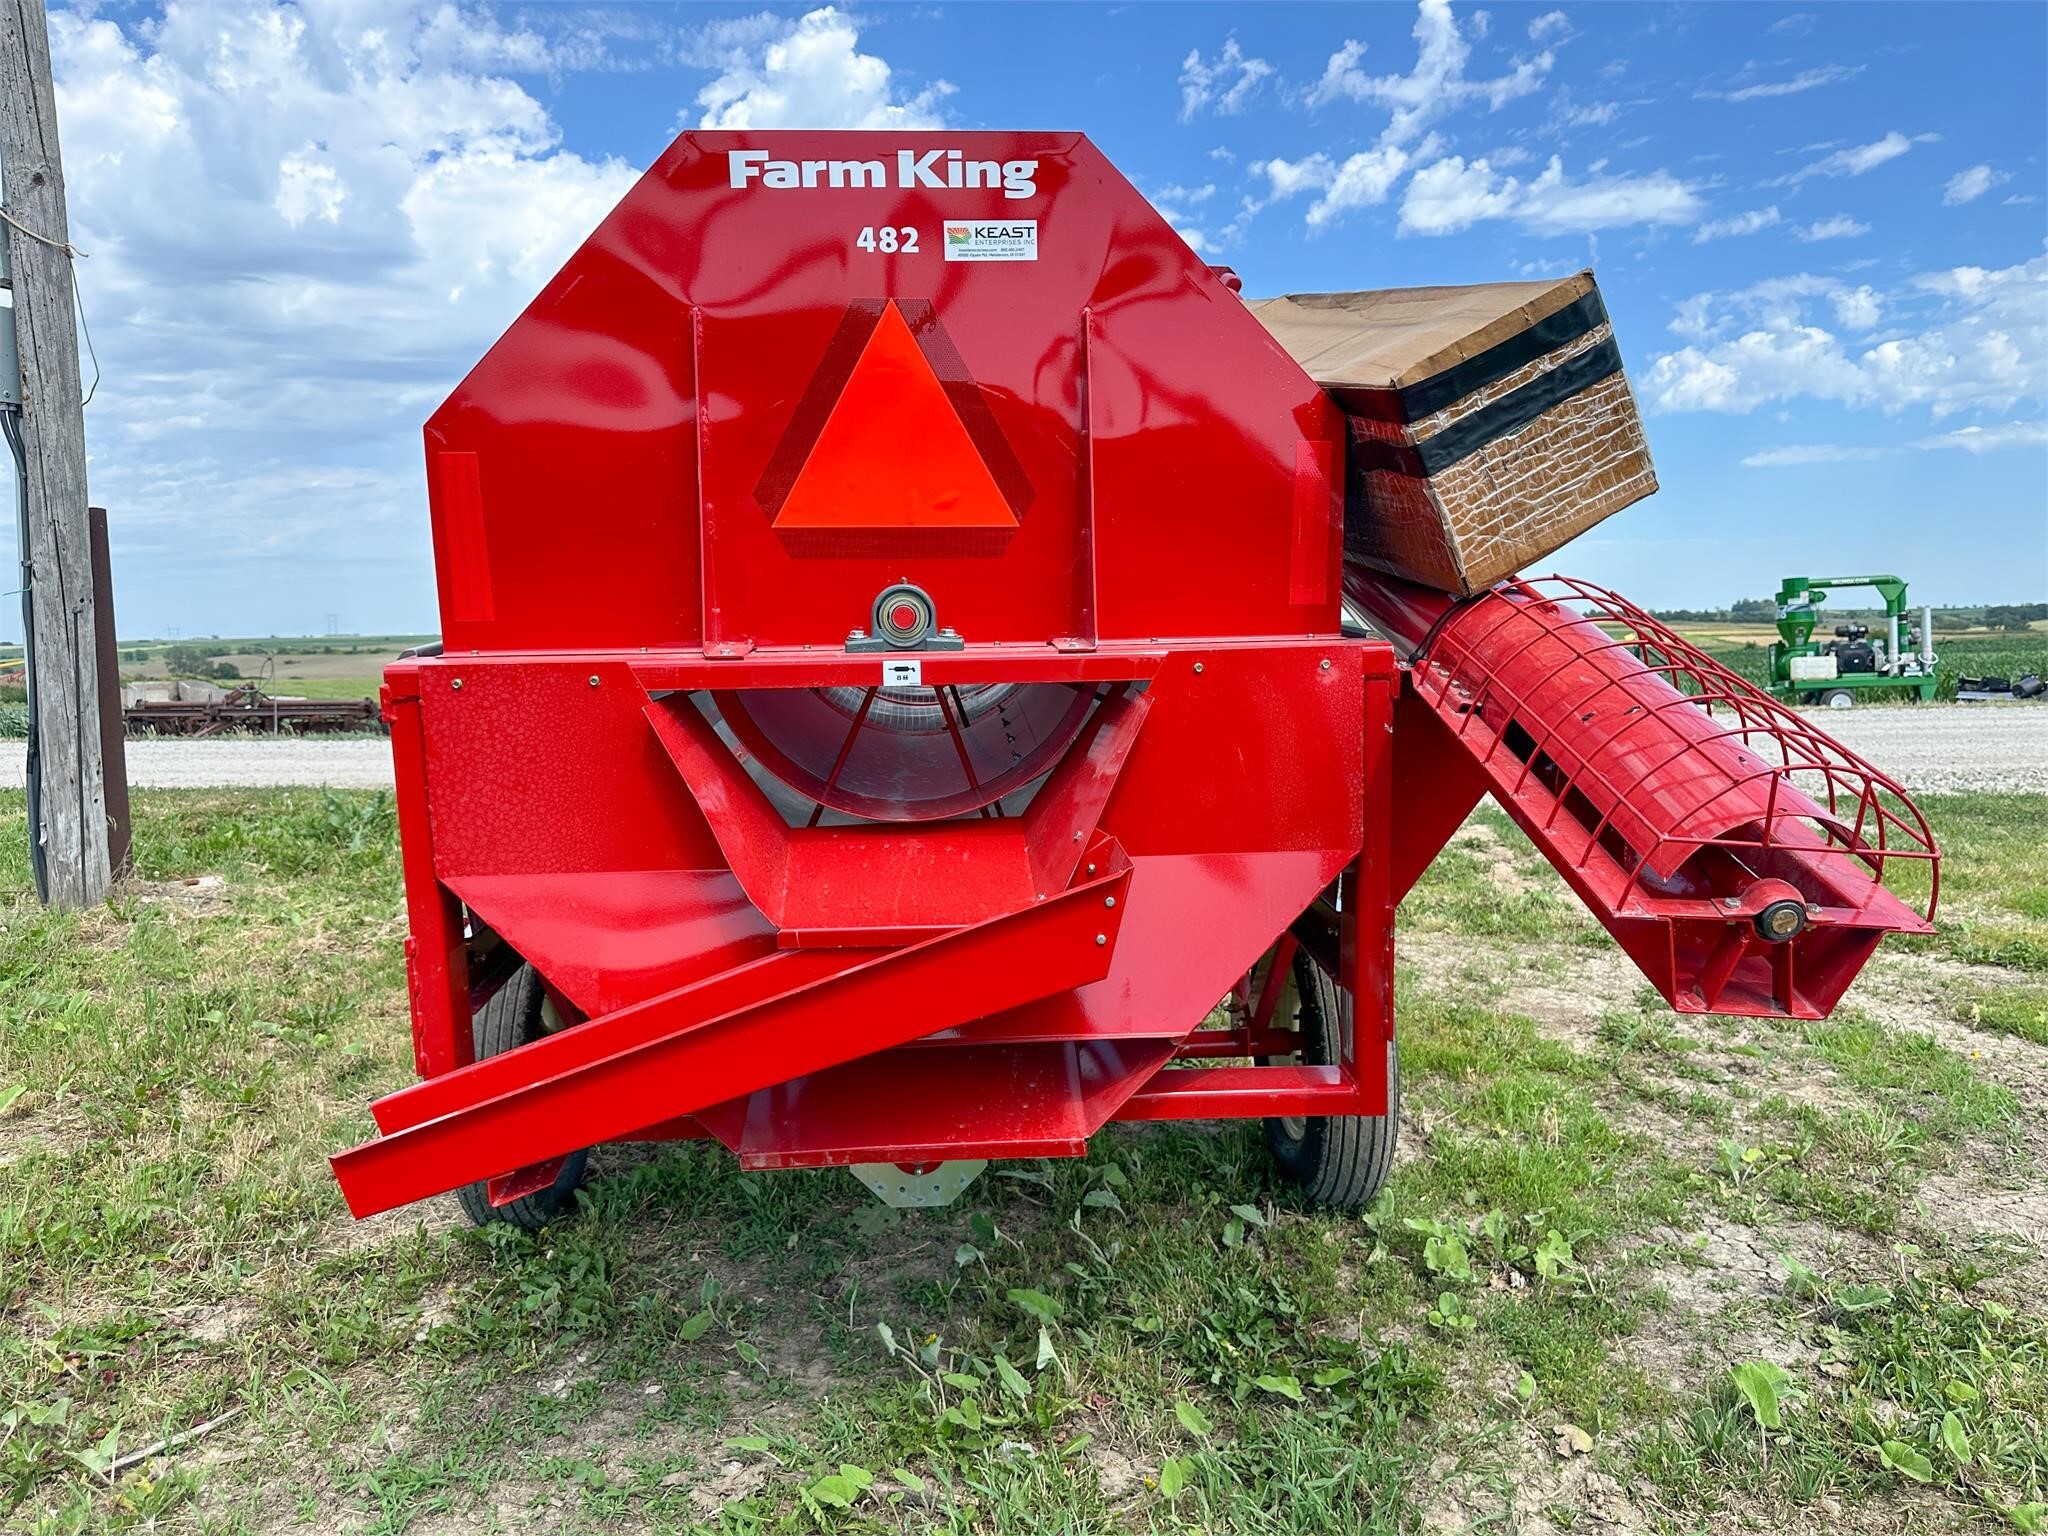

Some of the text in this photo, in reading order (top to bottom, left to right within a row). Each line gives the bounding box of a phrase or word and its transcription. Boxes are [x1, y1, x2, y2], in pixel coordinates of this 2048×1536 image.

[728, 149, 1039, 199] Farm King
[856, 226, 920, 254] 482
[975, 227, 1035, 239] KEAST
